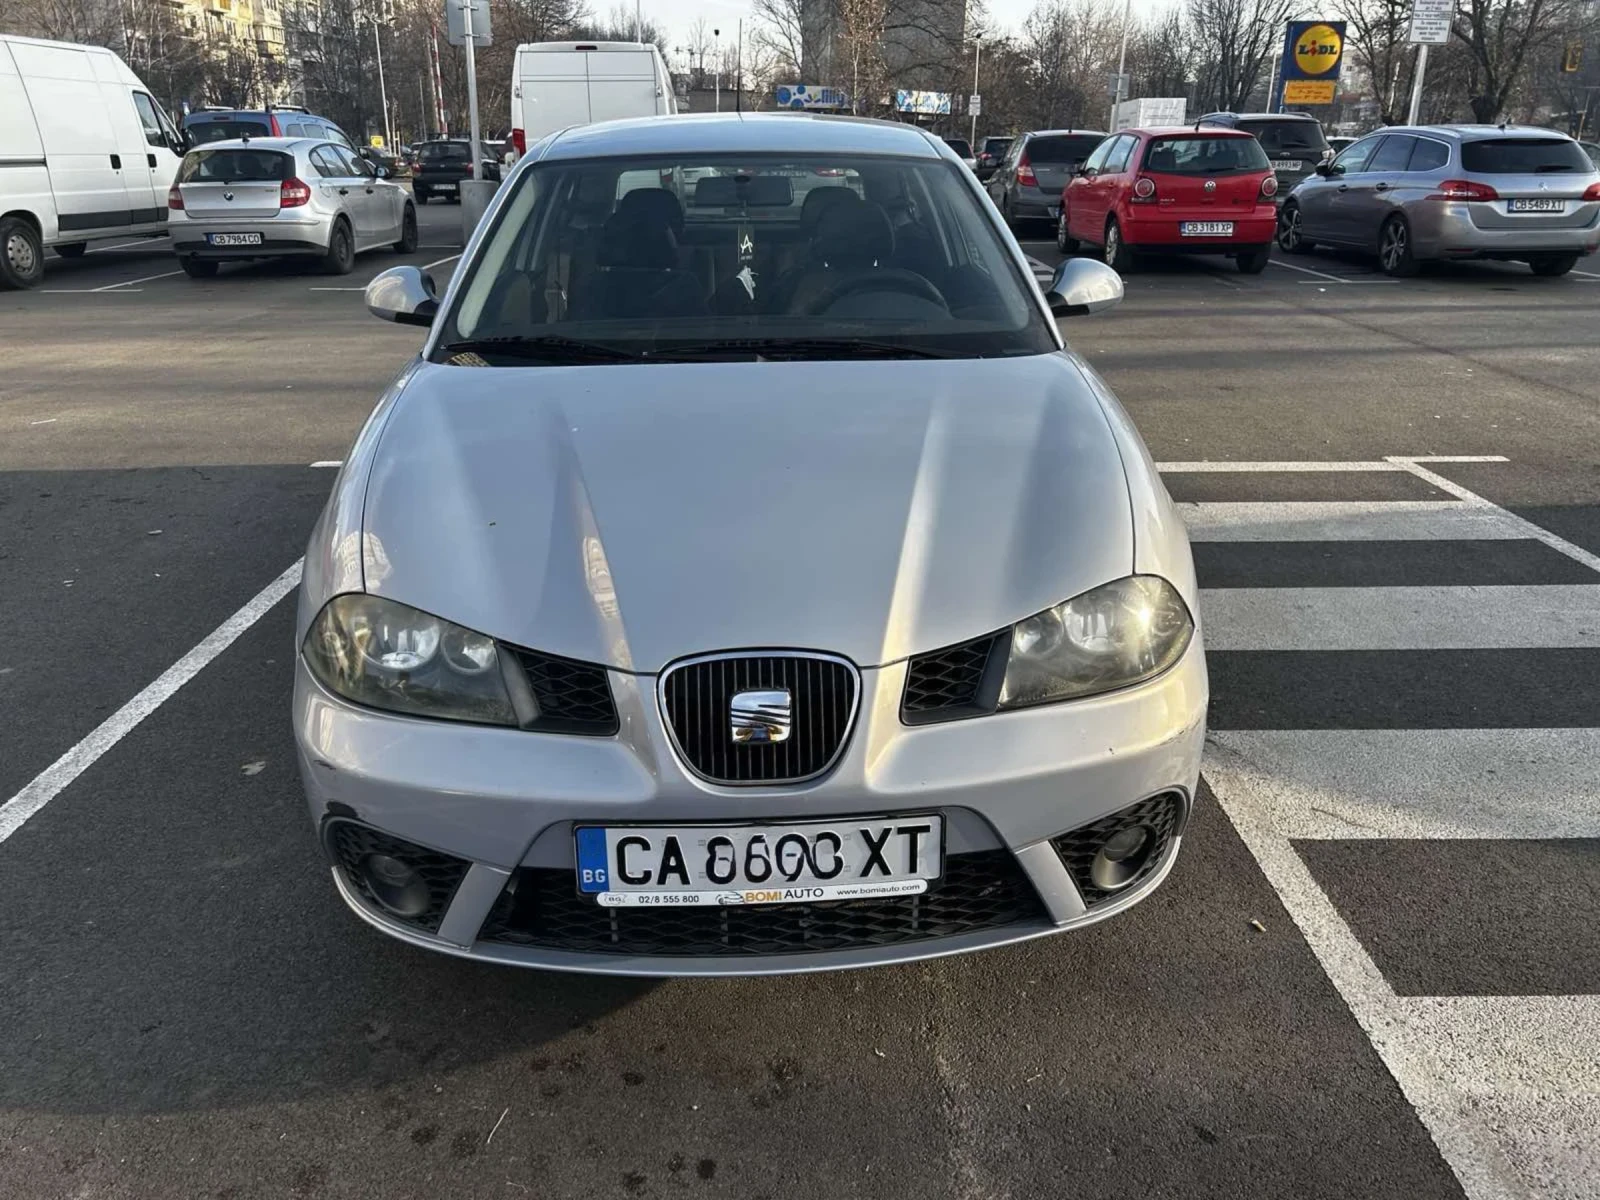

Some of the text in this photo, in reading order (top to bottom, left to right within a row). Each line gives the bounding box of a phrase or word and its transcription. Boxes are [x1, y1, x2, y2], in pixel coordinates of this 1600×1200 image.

[1515, 200, 1527, 209] CB
[1186, 223, 1232, 233] CB 3181 XP
[214, 234, 226, 244] CB
[226, 235, 247, 244] 7984
[583, 869, 606, 883] BG
[616, 835, 691, 885] CA
[860, 825, 931, 878] XT
[745, 888, 824, 902] BOMI AUTO
[837, 884, 920, 896] www.bomiauto.com
[638, 895, 699, 904] 02/8 555 800
